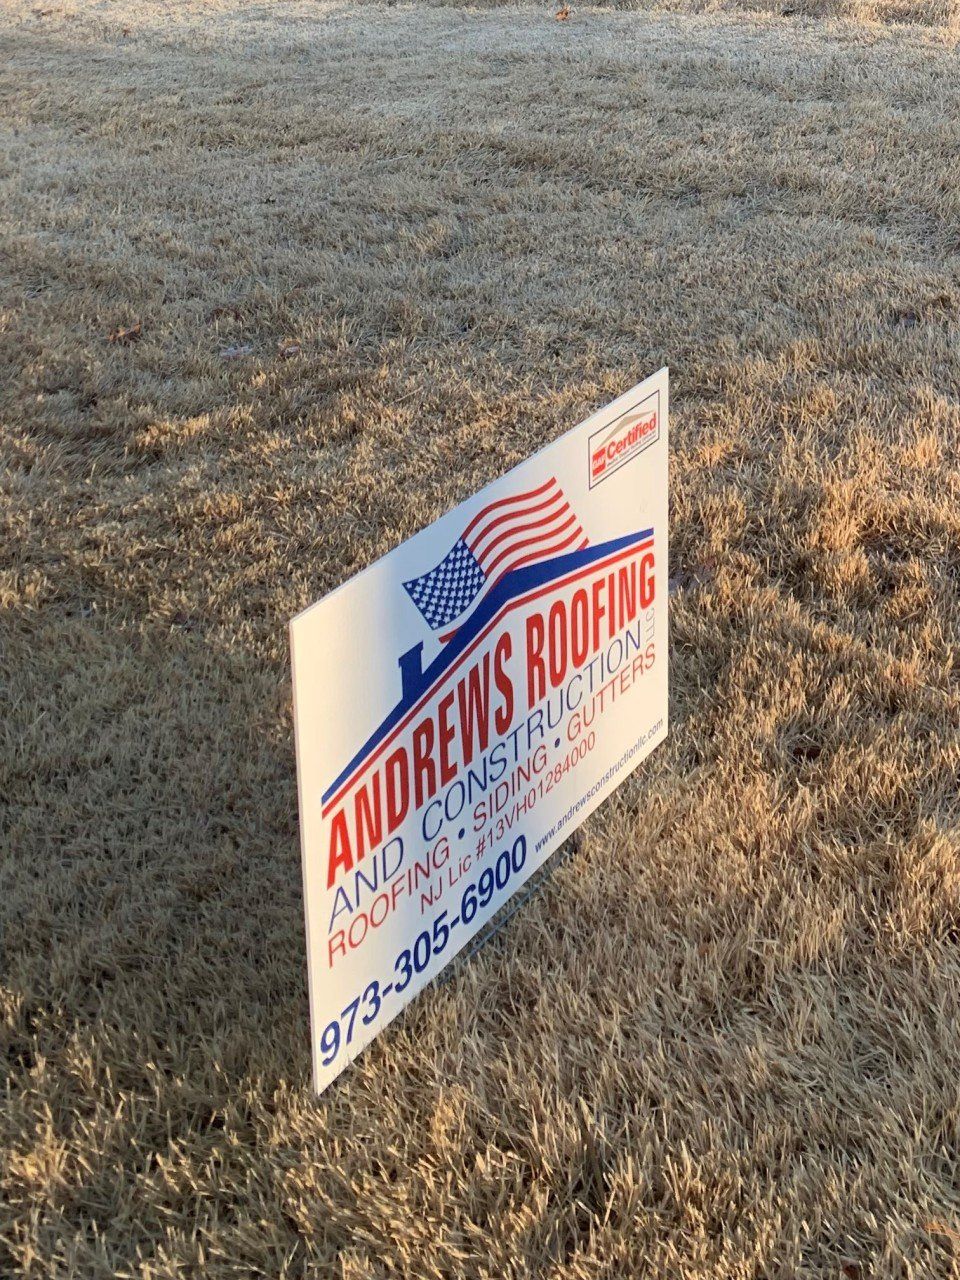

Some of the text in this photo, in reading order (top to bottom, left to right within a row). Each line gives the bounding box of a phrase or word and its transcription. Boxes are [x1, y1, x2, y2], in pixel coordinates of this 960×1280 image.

[607, 411, 657, 459] Certified
[326, 553, 656, 890] ANDREWS ROOFING
[646, 607, 656, 643] LLC
[328, 619, 641, 934] AND CONSTRUCTION
[328, 643, 656, 969] ROOFING SIDING GUTTERS
[420, 731, 596, 915] NJ Lic #13VH01284000
[534, 718, 664, 853] www.andrewsconstructionllc.com
[320, 834, 527, 1067] 973-305-6900
